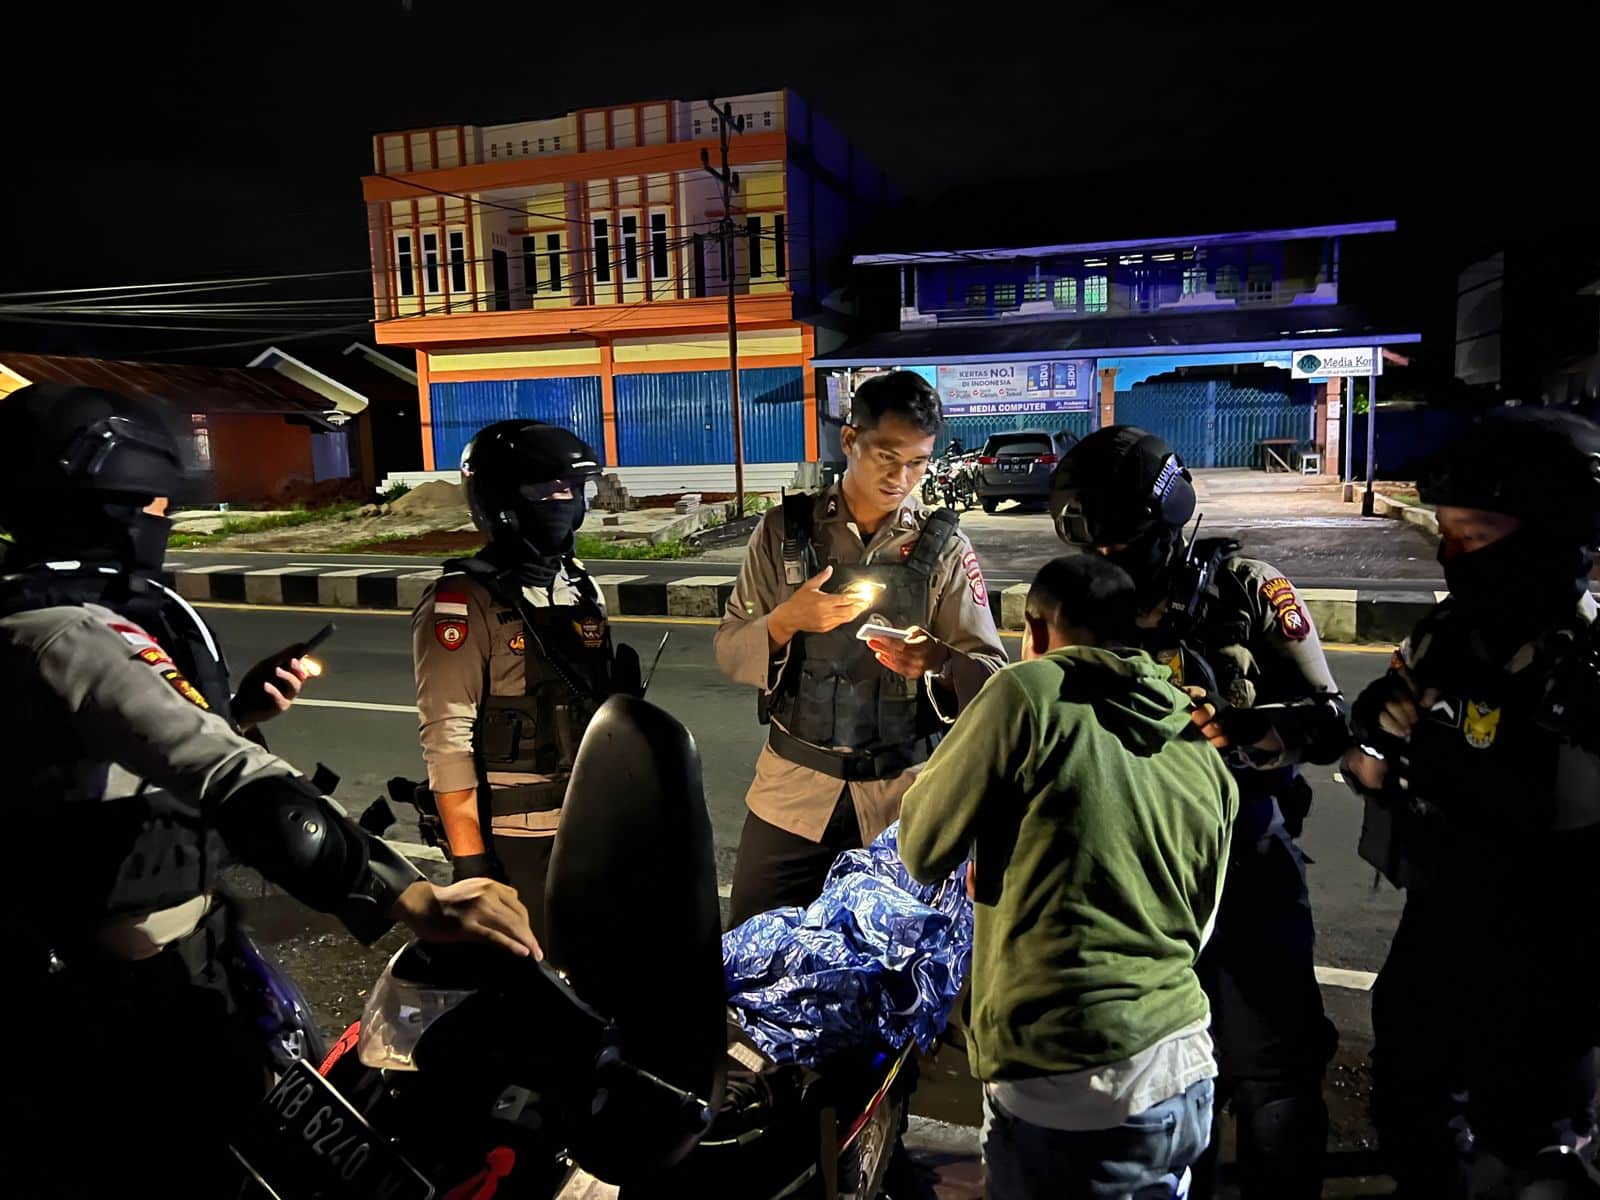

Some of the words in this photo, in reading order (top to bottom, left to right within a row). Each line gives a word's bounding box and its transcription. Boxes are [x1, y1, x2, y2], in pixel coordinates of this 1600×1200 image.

[1323, 356, 1353, 369] Media
[959, 369, 988, 378] KERTAS
[990, 366, 1015, 378] NO.1
[1040, 364, 1049, 387] SIDU
[1067, 365, 1076, 387] SIDU
[971, 379, 1012, 387] INDONESIA
[969, 404, 997, 413] MEDIA
[998, 402, 1047, 412] COMPUTER
[269, 1069, 314, 1119] KB
[302, 1105, 371, 1181] 6240
